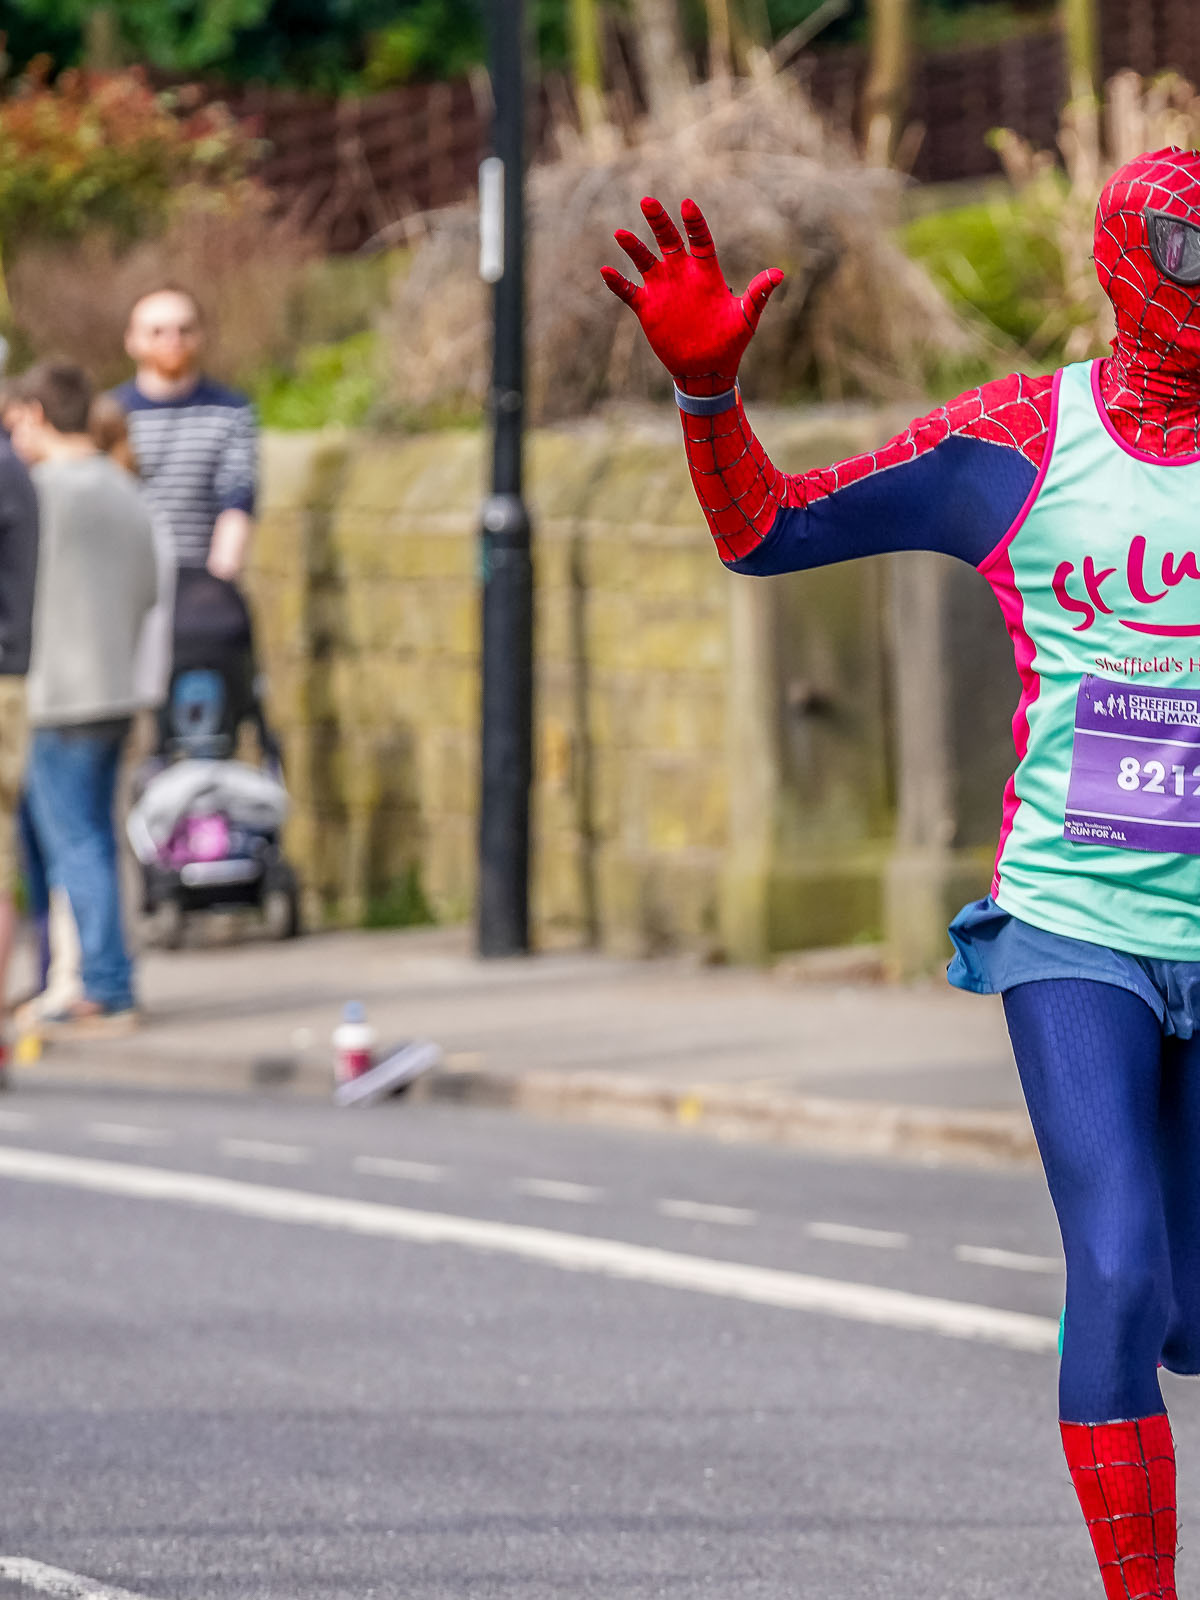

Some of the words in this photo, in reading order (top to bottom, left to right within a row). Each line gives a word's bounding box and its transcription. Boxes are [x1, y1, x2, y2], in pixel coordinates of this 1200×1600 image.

[1094, 656, 1183, 676] Sheffield's
[1130, 695, 1197, 713] SHEFFIELD
[1130, 709, 1165, 724] HALF
[1070, 826, 1091, 837] RUN
[1091, 828, 1109, 839] FOR
[1110, 831, 1127, 841] ALL
